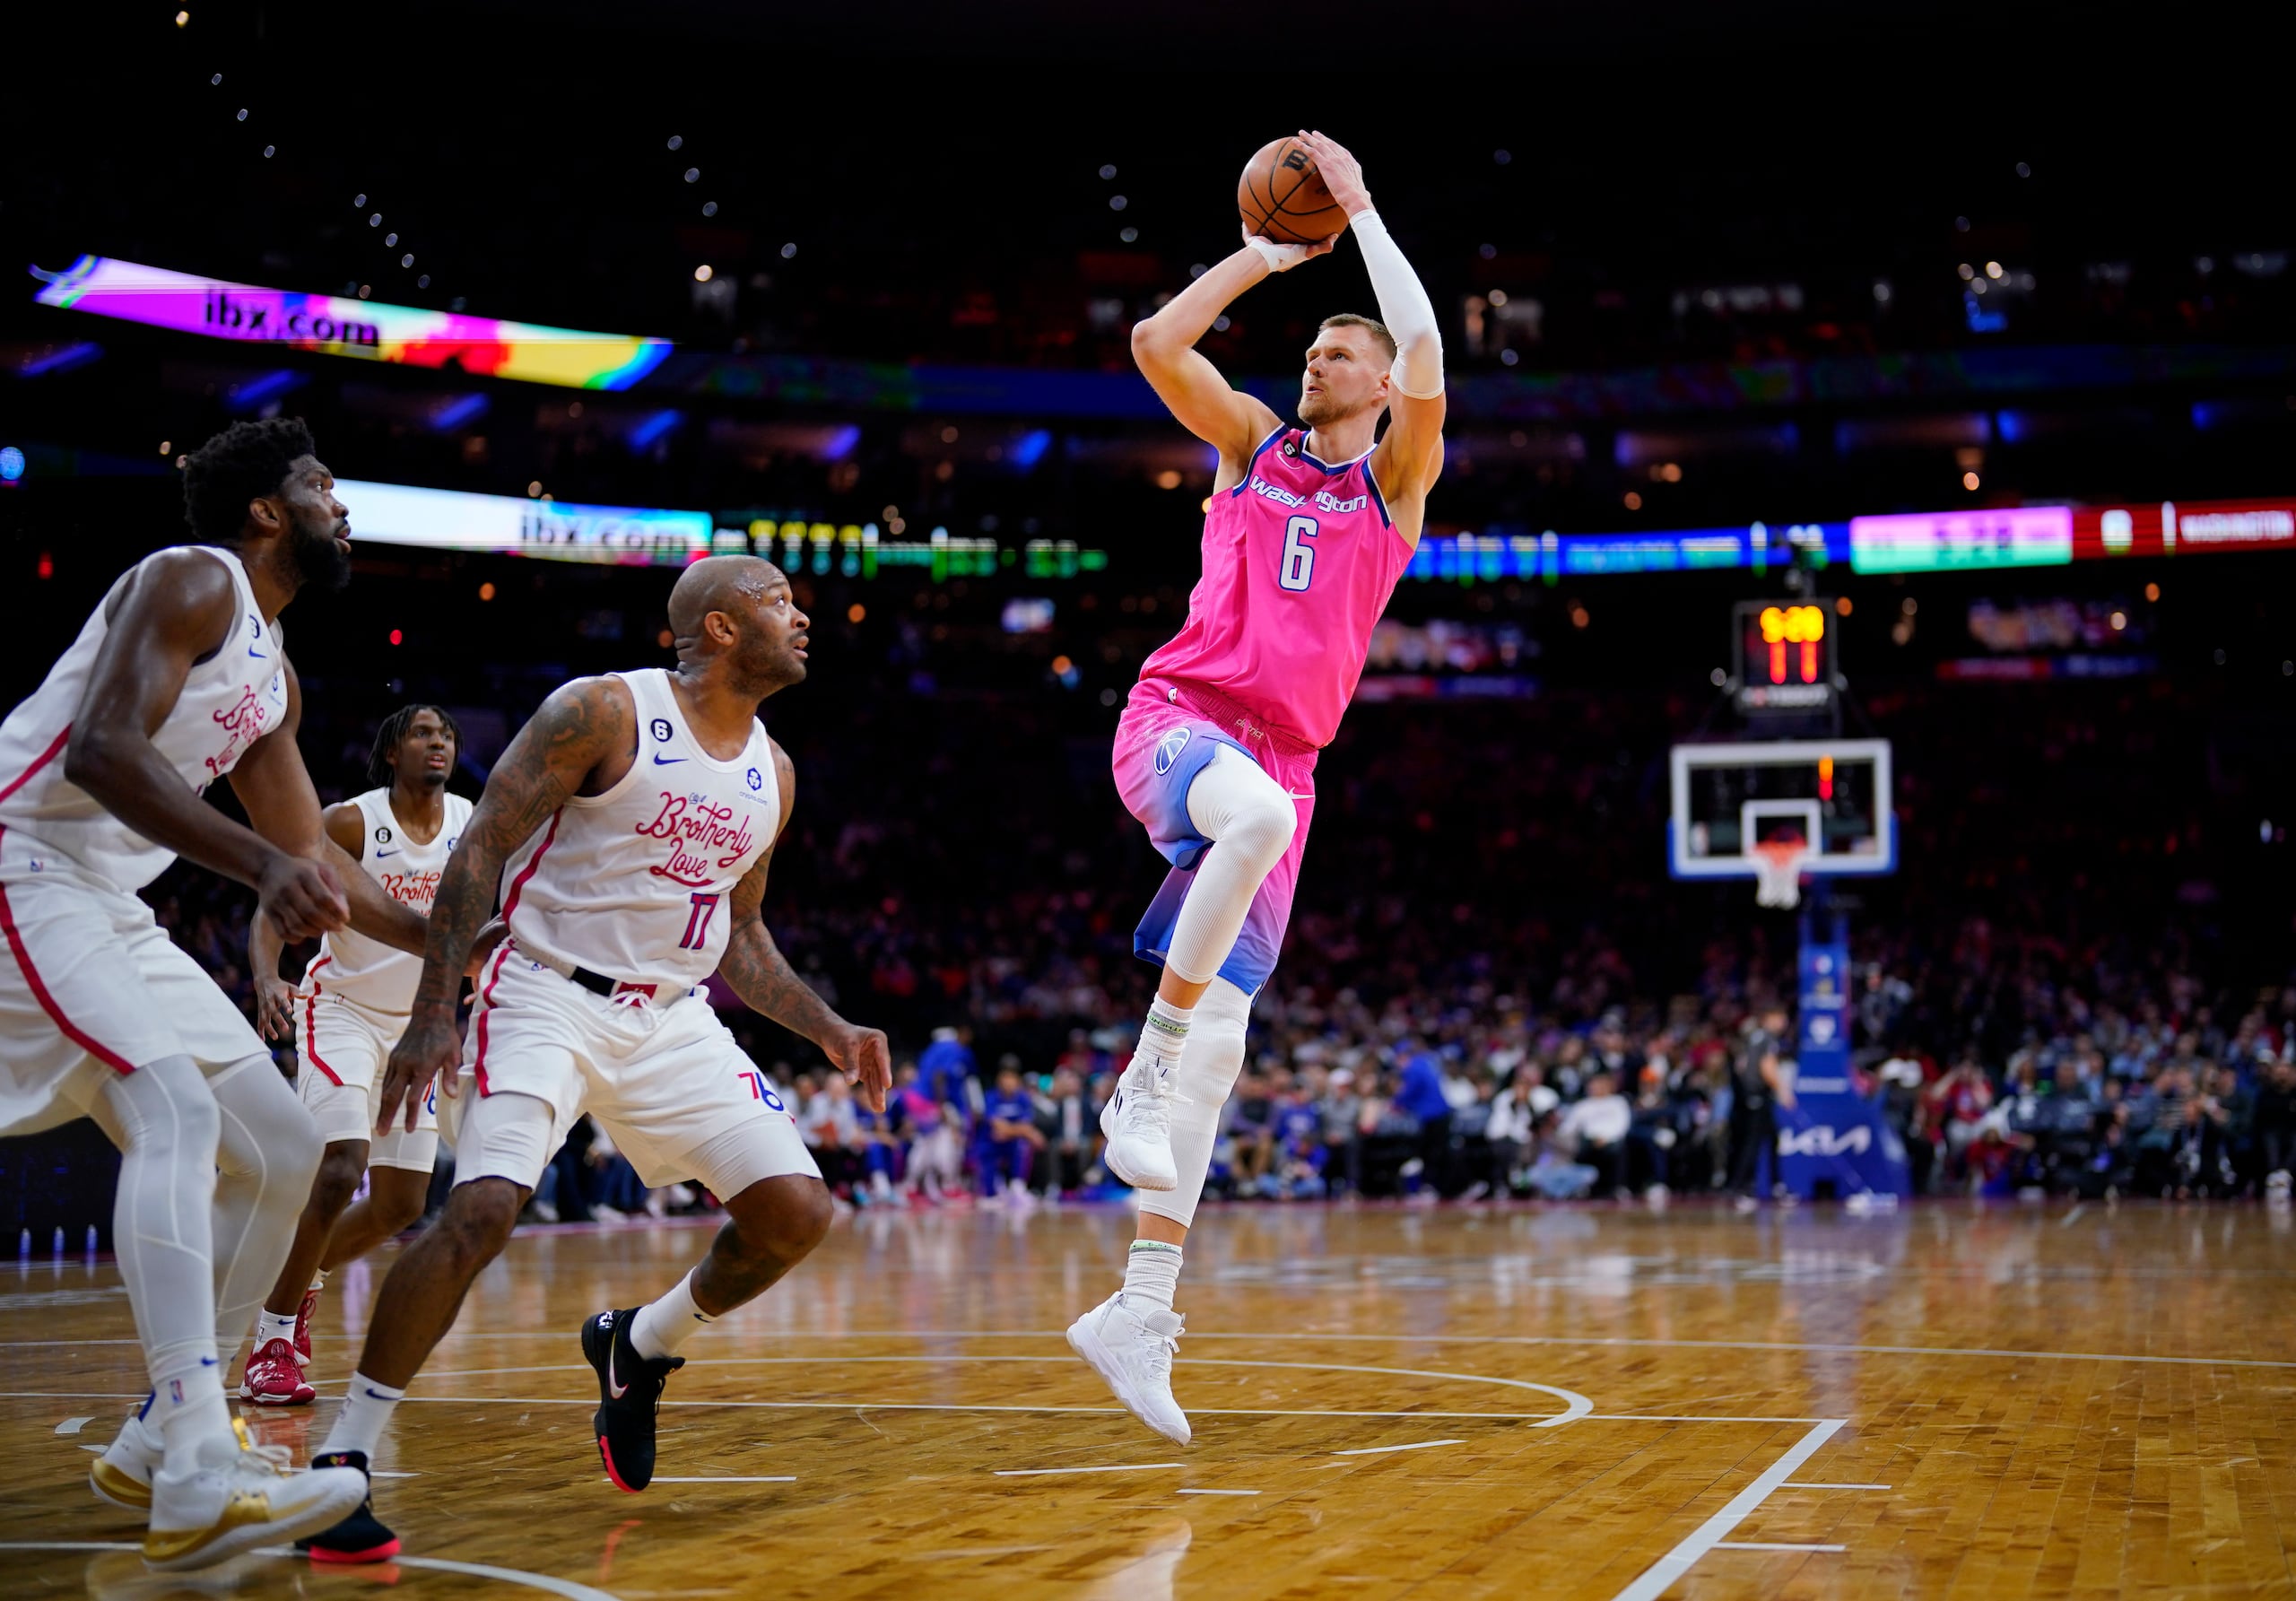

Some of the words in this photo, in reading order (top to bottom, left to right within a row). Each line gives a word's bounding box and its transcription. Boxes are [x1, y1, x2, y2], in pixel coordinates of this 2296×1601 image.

[206, 289, 379, 348] ibx.com
[1249, 475, 1368, 513] washngton
[1279, 515, 1318, 592] 6
[654, 722, 670, 741] 6
[636, 791, 752, 868] Brotherly
[649, 837, 716, 887] Love
[679, 892, 719, 950] 17
[737, 1072, 784, 1111] 76
